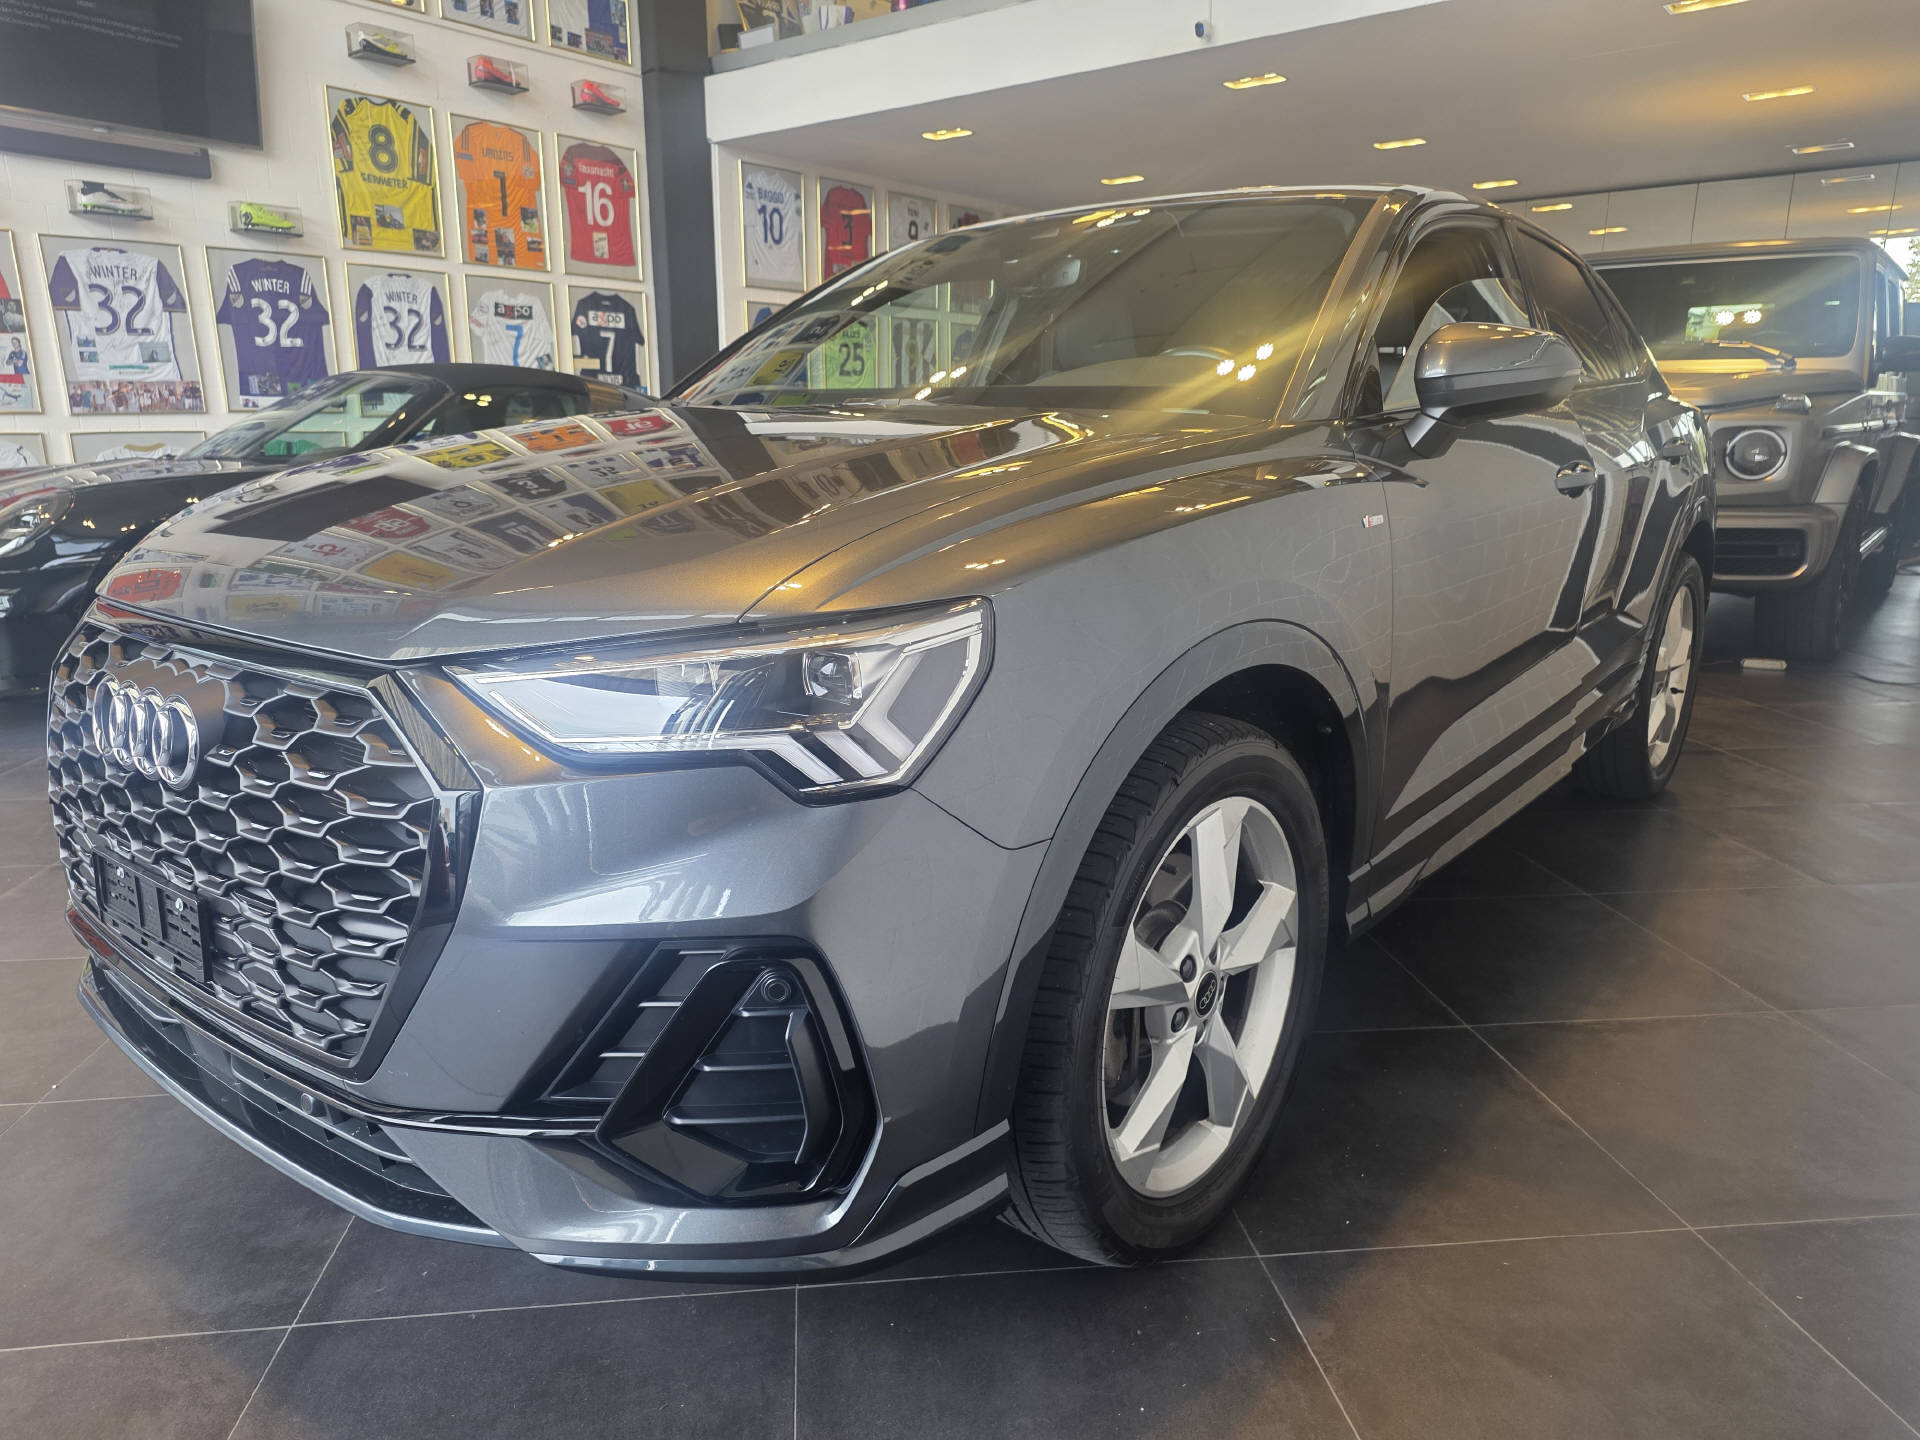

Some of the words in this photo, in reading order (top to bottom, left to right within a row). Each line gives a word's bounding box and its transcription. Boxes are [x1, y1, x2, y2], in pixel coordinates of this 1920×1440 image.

[368, 123, 398, 173] 8
[493, 170, 508, 217] 1
[578, 180, 615, 227] 16
[757, 204, 783, 245] 10
[89, 264, 138, 281] WINTER
[251, 277, 290, 295] WINTER
[88, 283, 154, 336] 32
[385, 289, 418, 305] WINTER
[250, 297, 304, 348] 32
[383, 305, 428, 352] 32
[505, 324, 524, 367] 7
[600, 331, 616, 373] 7
[838, 343, 865, 377] 25
